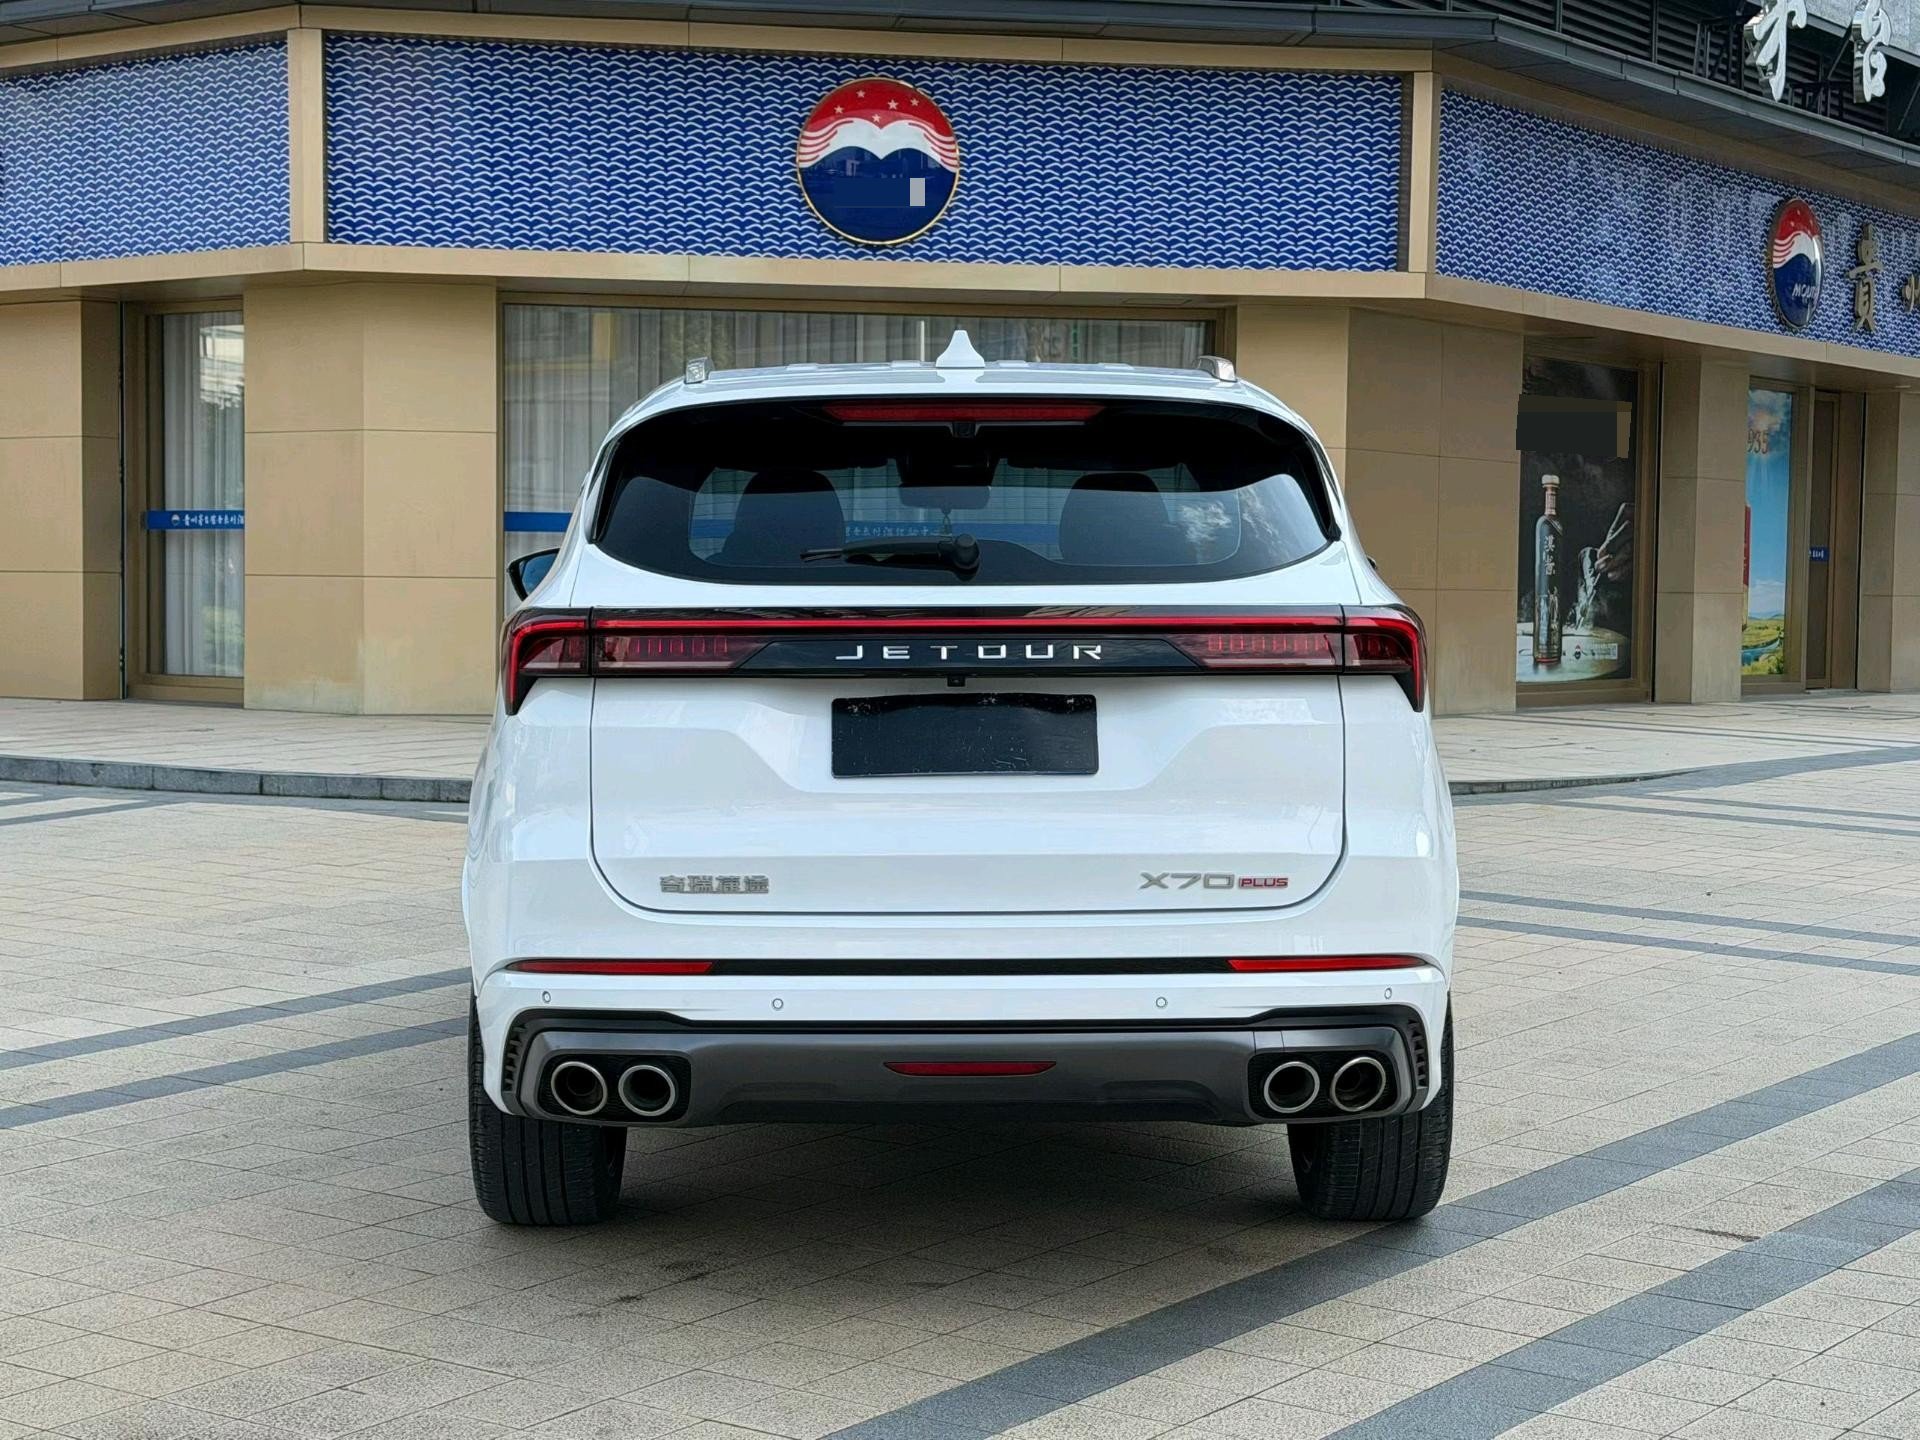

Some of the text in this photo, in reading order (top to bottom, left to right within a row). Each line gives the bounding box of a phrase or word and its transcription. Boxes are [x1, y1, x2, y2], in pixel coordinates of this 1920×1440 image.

[835, 644, 1103, 661] JETOUR
[660, 875, 769, 894] 奇瑞捷途
[1138, 872, 1289, 890] X70 PLUS
